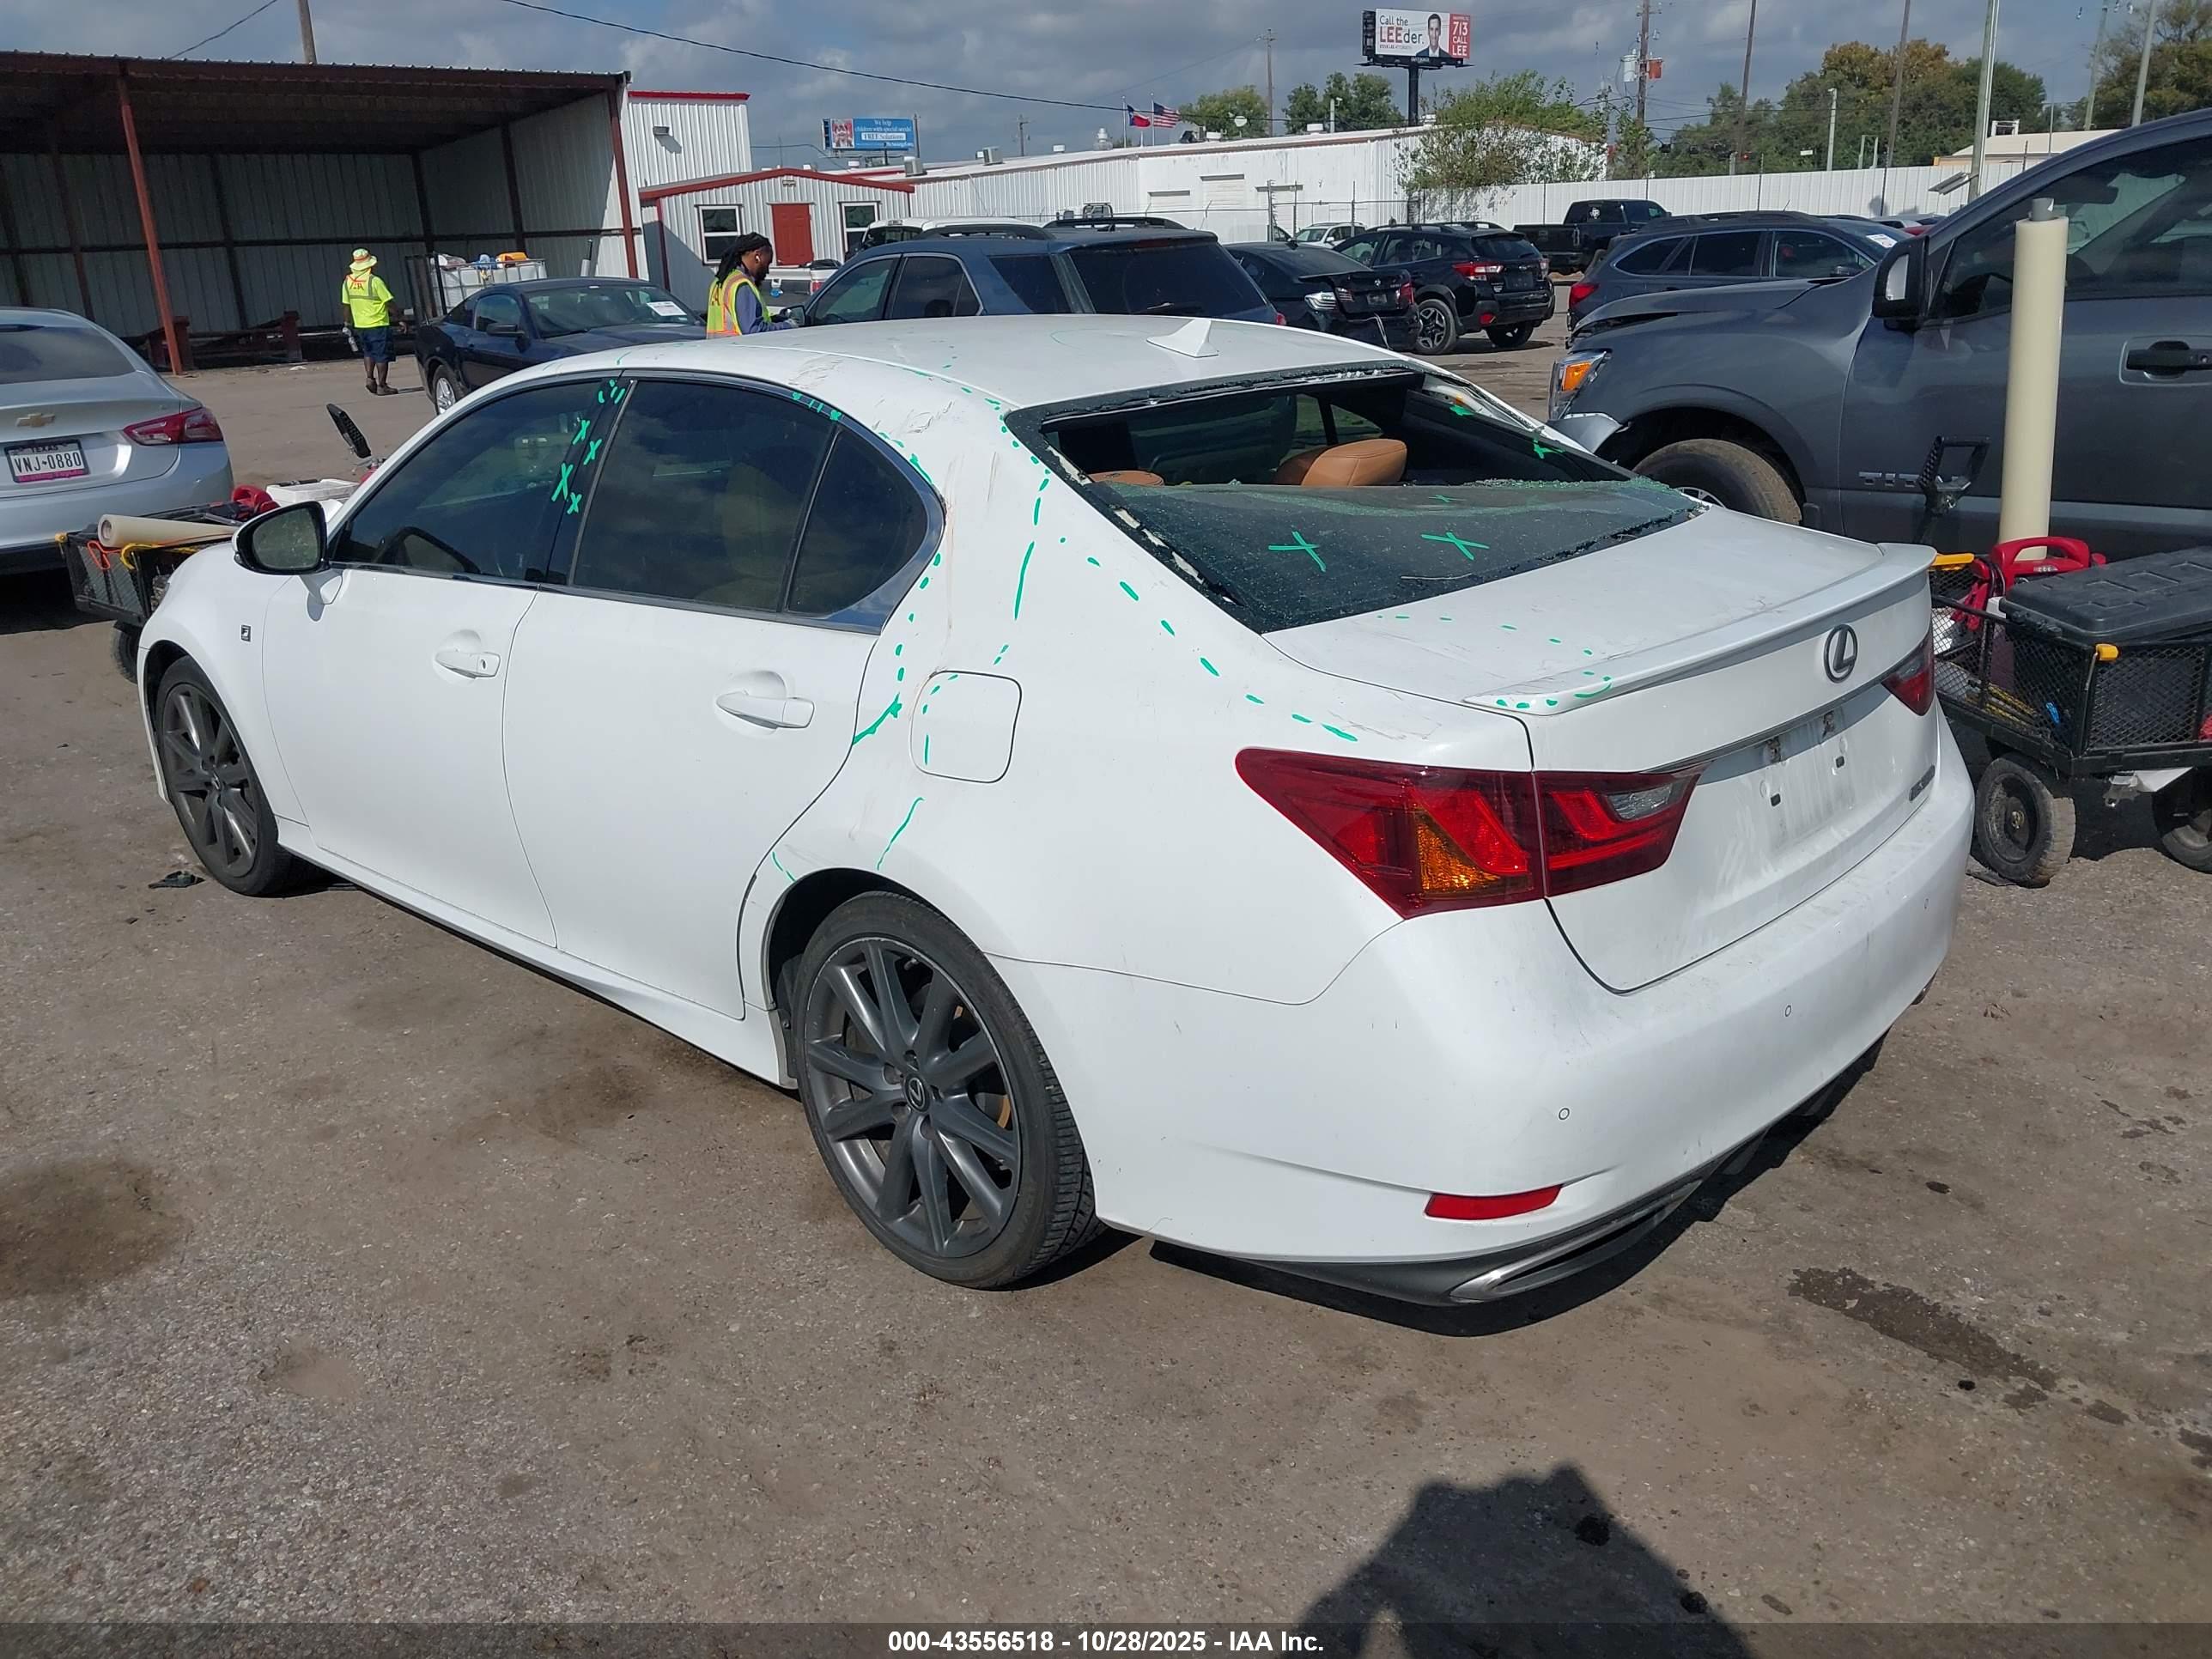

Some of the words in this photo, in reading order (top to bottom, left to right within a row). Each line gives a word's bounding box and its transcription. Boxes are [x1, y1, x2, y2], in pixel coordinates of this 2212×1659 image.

[1379, 15, 1395, 26] Call
[1396, 15, 1409, 27] the
[1453, 21, 1468, 36] 713
[1380, 26, 1425, 44] LEEder.
[1452, 35, 1468, 45] CALL
[1452, 45, 1468, 57] LEE
[31, 445, 59, 453] TEXAS
[14, 456, 41, 473] VNJ
[46, 452, 82, 470] 0880
